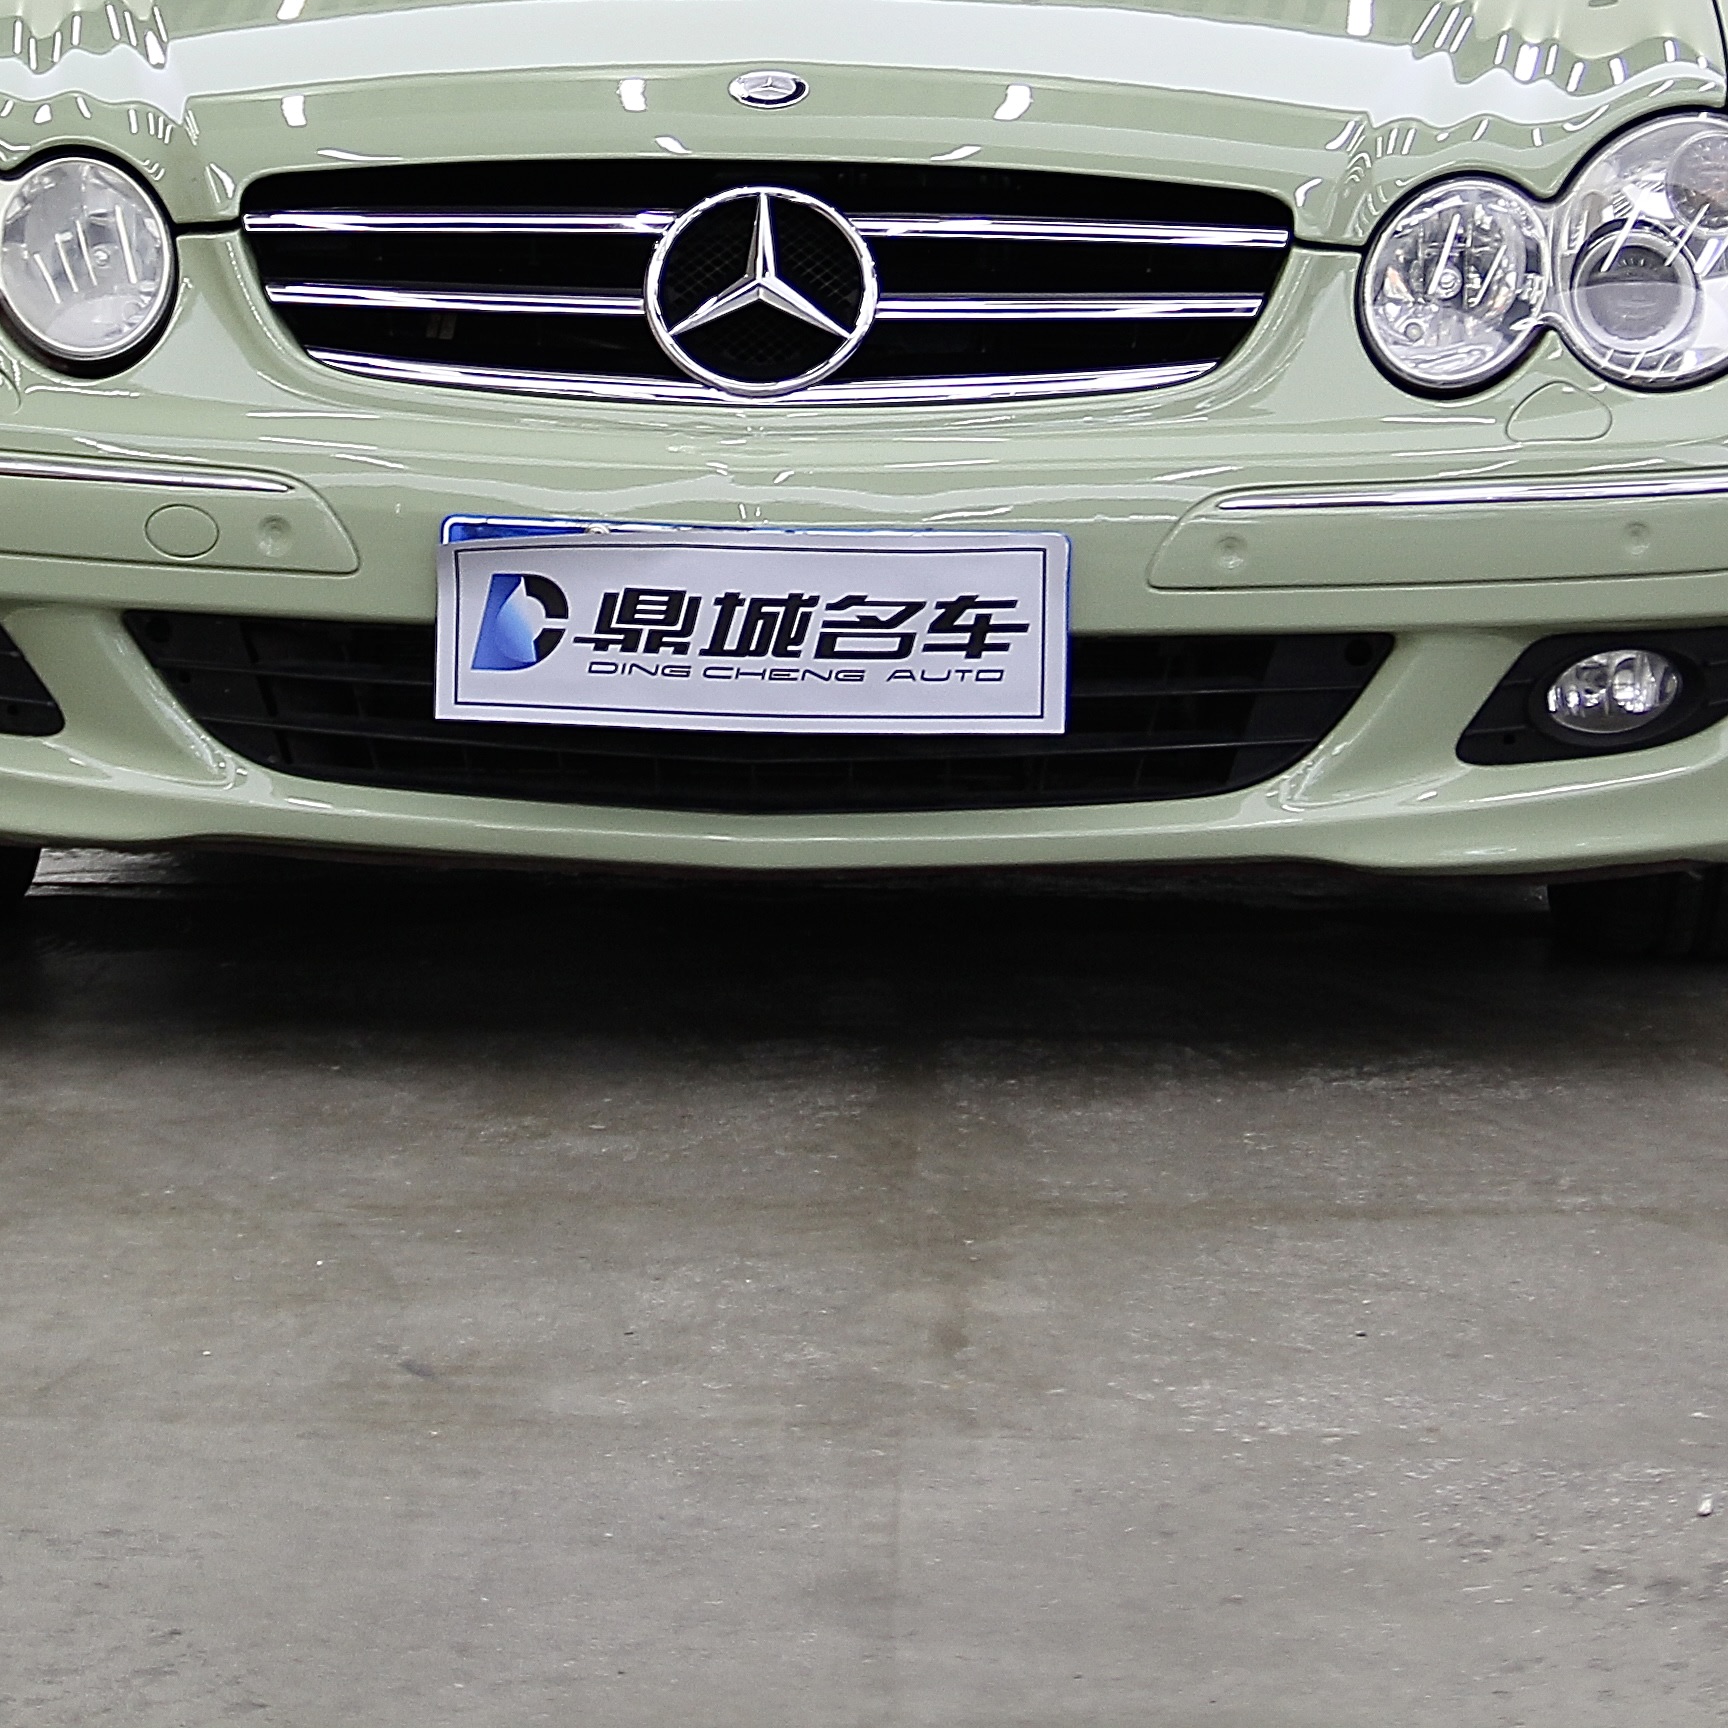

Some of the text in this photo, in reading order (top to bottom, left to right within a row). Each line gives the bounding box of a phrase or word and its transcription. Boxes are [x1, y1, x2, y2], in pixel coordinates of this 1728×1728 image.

[573, 587, 1030, 660] 鼎城名车
[587, 661, 1006, 683] DING CHENG AUTO
